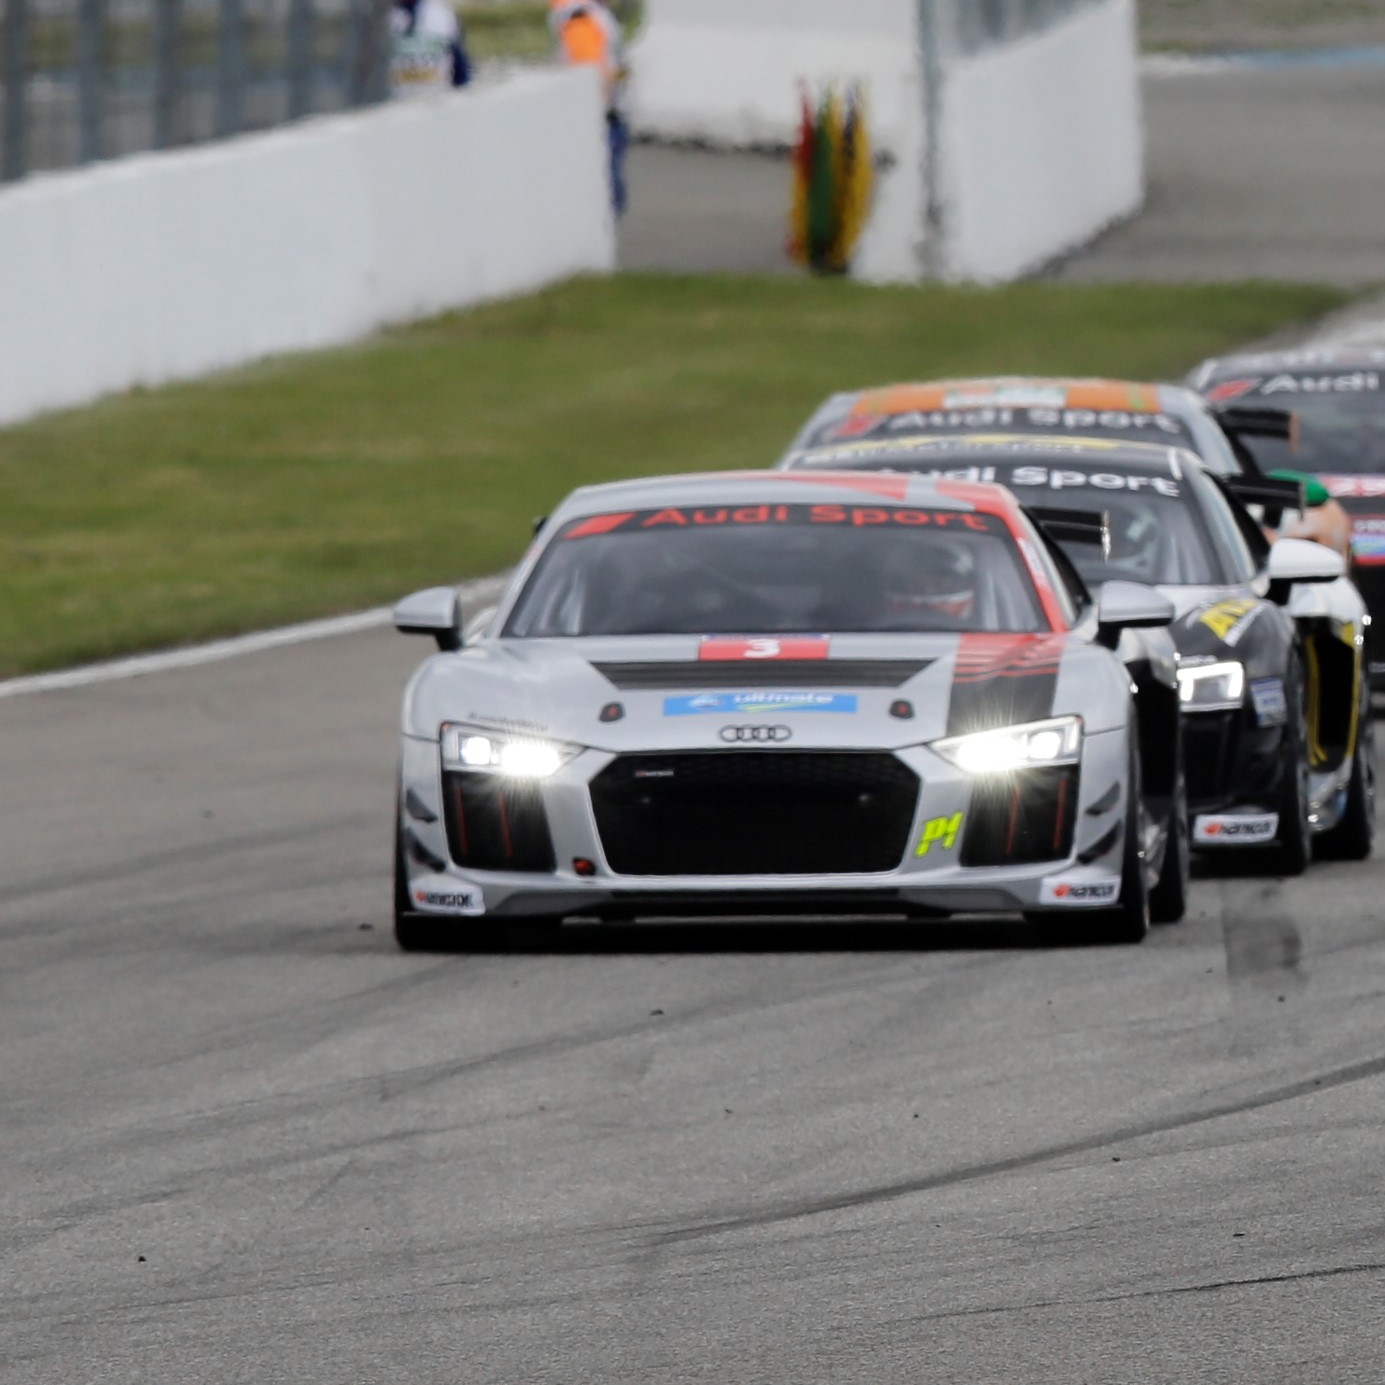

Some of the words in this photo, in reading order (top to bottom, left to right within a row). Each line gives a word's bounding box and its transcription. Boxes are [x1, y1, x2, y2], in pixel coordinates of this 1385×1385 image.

[1260, 371, 1379, 396] Audi
[889, 409, 1013, 430] Audi
[1027, 408, 1183, 435] Sport
[1010, 465, 1180, 498] Sport
[642, 505, 787, 527] Audi
[811, 504, 989, 531] Sport
[743, 638, 781, 659] 3
